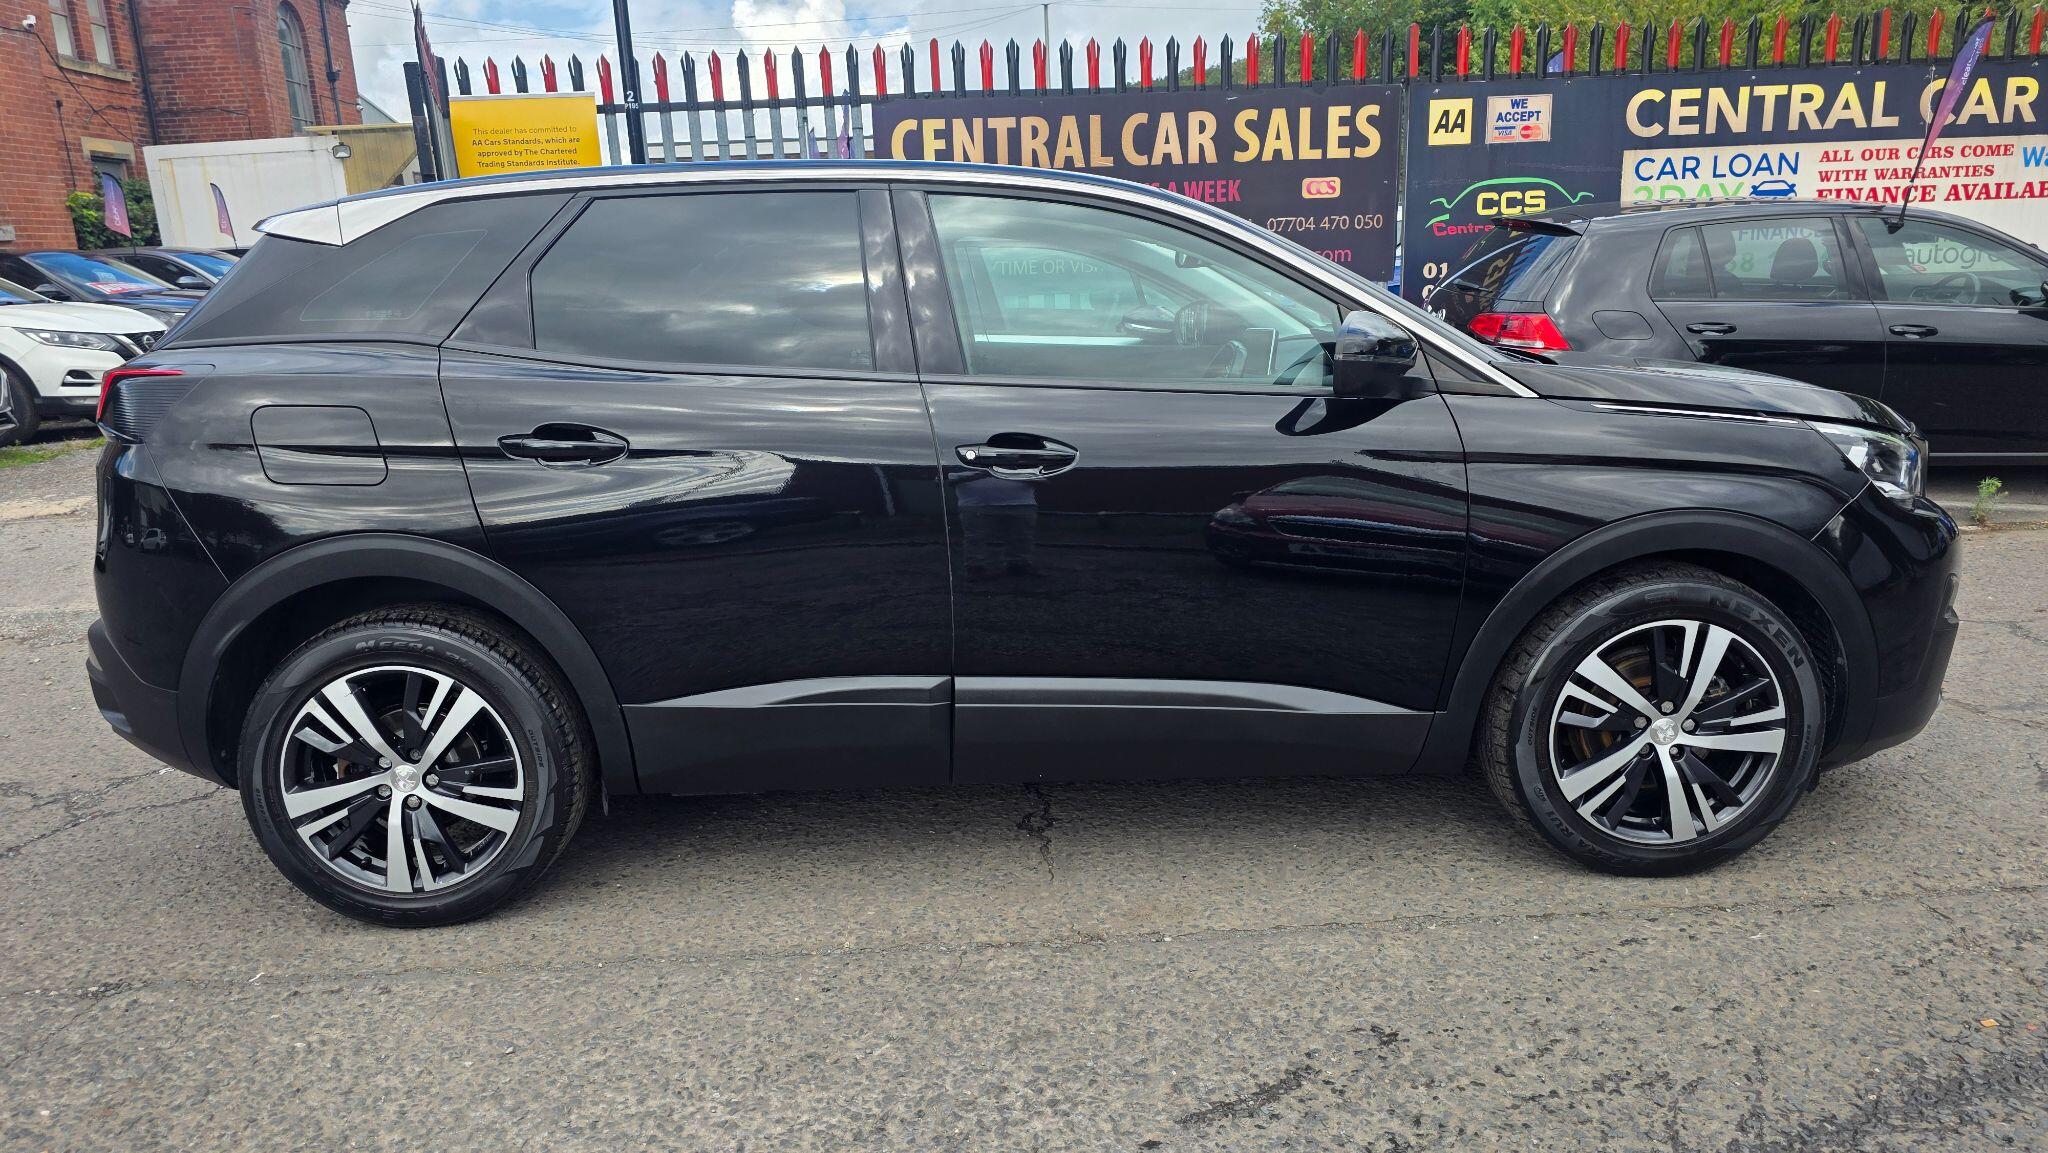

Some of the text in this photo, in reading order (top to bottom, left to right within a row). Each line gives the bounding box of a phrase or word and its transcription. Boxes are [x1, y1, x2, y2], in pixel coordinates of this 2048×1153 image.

[626, 90, 635, 102] 2
[1510, 98, 1529, 110] WE
[1626, 76, 2040, 137] CENTRAL CAR
[1434, 108, 1467, 134] AA
[1496, 110, 1542, 123] ACCEPT
[473, 128, 489, 136] This
[490, 127, 513, 135] dealer
[529, 125, 568, 134] committed
[569, 125, 578, 133] to
[891, 104, 1382, 169] CENTRAL CAR SALES
[472, 139, 483, 147] AA
[484, 138, 502, 146] Cars
[503, 137, 544, 146] Standards,
[545, 136, 567, 144] which
[477, 147, 578, 158] approved by The Chartered
[1819, 143, 2015, 163] ALL OUR CARS COME
[477, 158, 581, 169] Trading Standards Institute.
[1634, 151, 1800, 182] CAR LOAN
[1818, 164, 1995, 183] WITH WARRANTIES
[1183, 179, 1242, 203] WEEK
[1816, 185, 1937, 204] FINANCE
[1476, 190, 1546, 216] CCS
[1267, 213, 1383, 232] 07704 470 050
[1710, 591, 1805, 669] NEXEN
[1527, 705, 1538, 746] OUTSIDE
